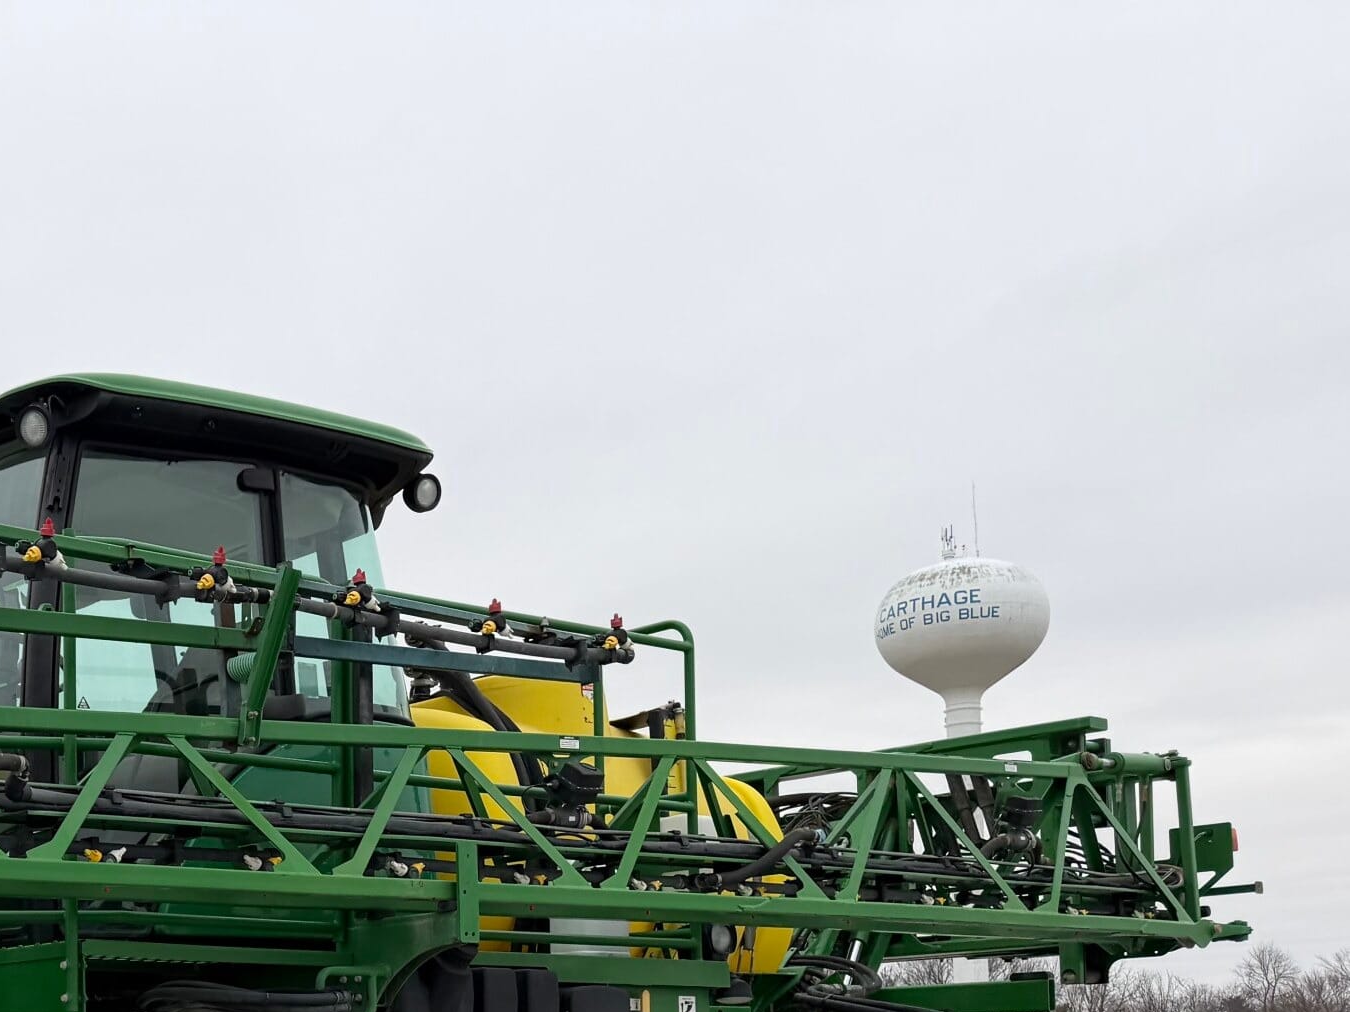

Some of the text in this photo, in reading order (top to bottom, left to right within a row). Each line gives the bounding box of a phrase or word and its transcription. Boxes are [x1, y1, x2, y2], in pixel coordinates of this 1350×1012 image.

[880, 589, 981, 623] CARTHAGE
[900, 617, 915, 631] OF
[923, 611, 950, 626] BIG
[959, 606, 1000, 620] BLUE
